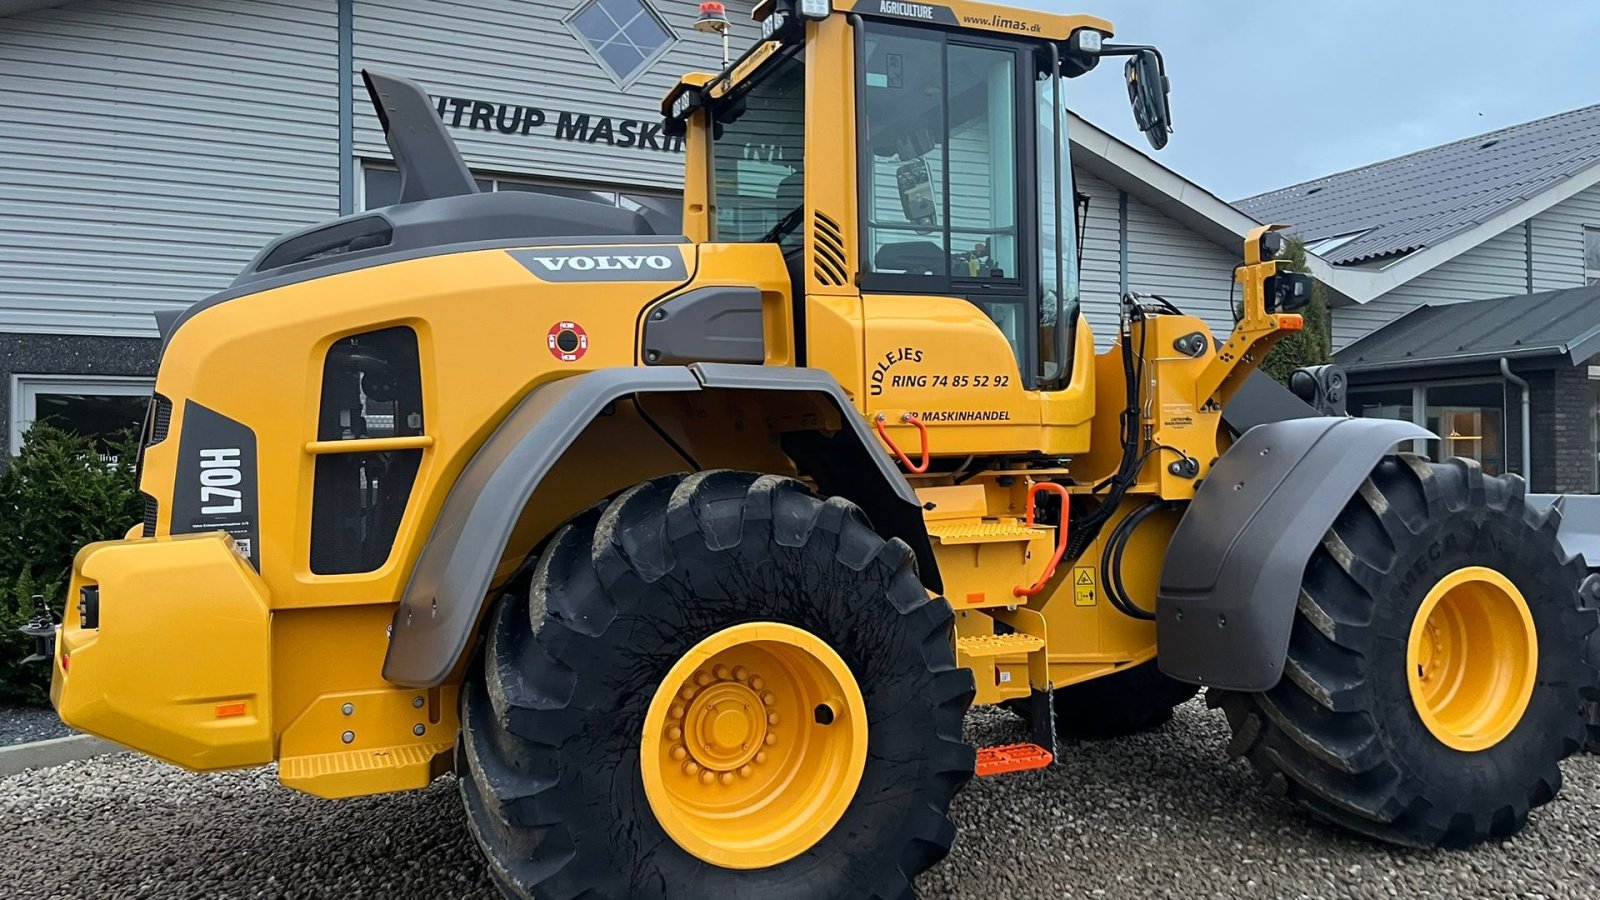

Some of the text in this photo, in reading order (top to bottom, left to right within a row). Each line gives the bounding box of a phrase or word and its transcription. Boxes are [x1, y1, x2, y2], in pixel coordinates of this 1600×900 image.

[880, 0, 934, 19] AGRICULTURE
[963, 15, 1041, 33] www.limas.dk
[533, 255, 672, 271] VOLVO
[870, 347, 923, 396] UDLEJES
[891, 375, 1009, 387] RING 74 85 52 92
[921, 411, 1010, 421] MASKINHANDEL
[200, 448, 242, 514] L70H
